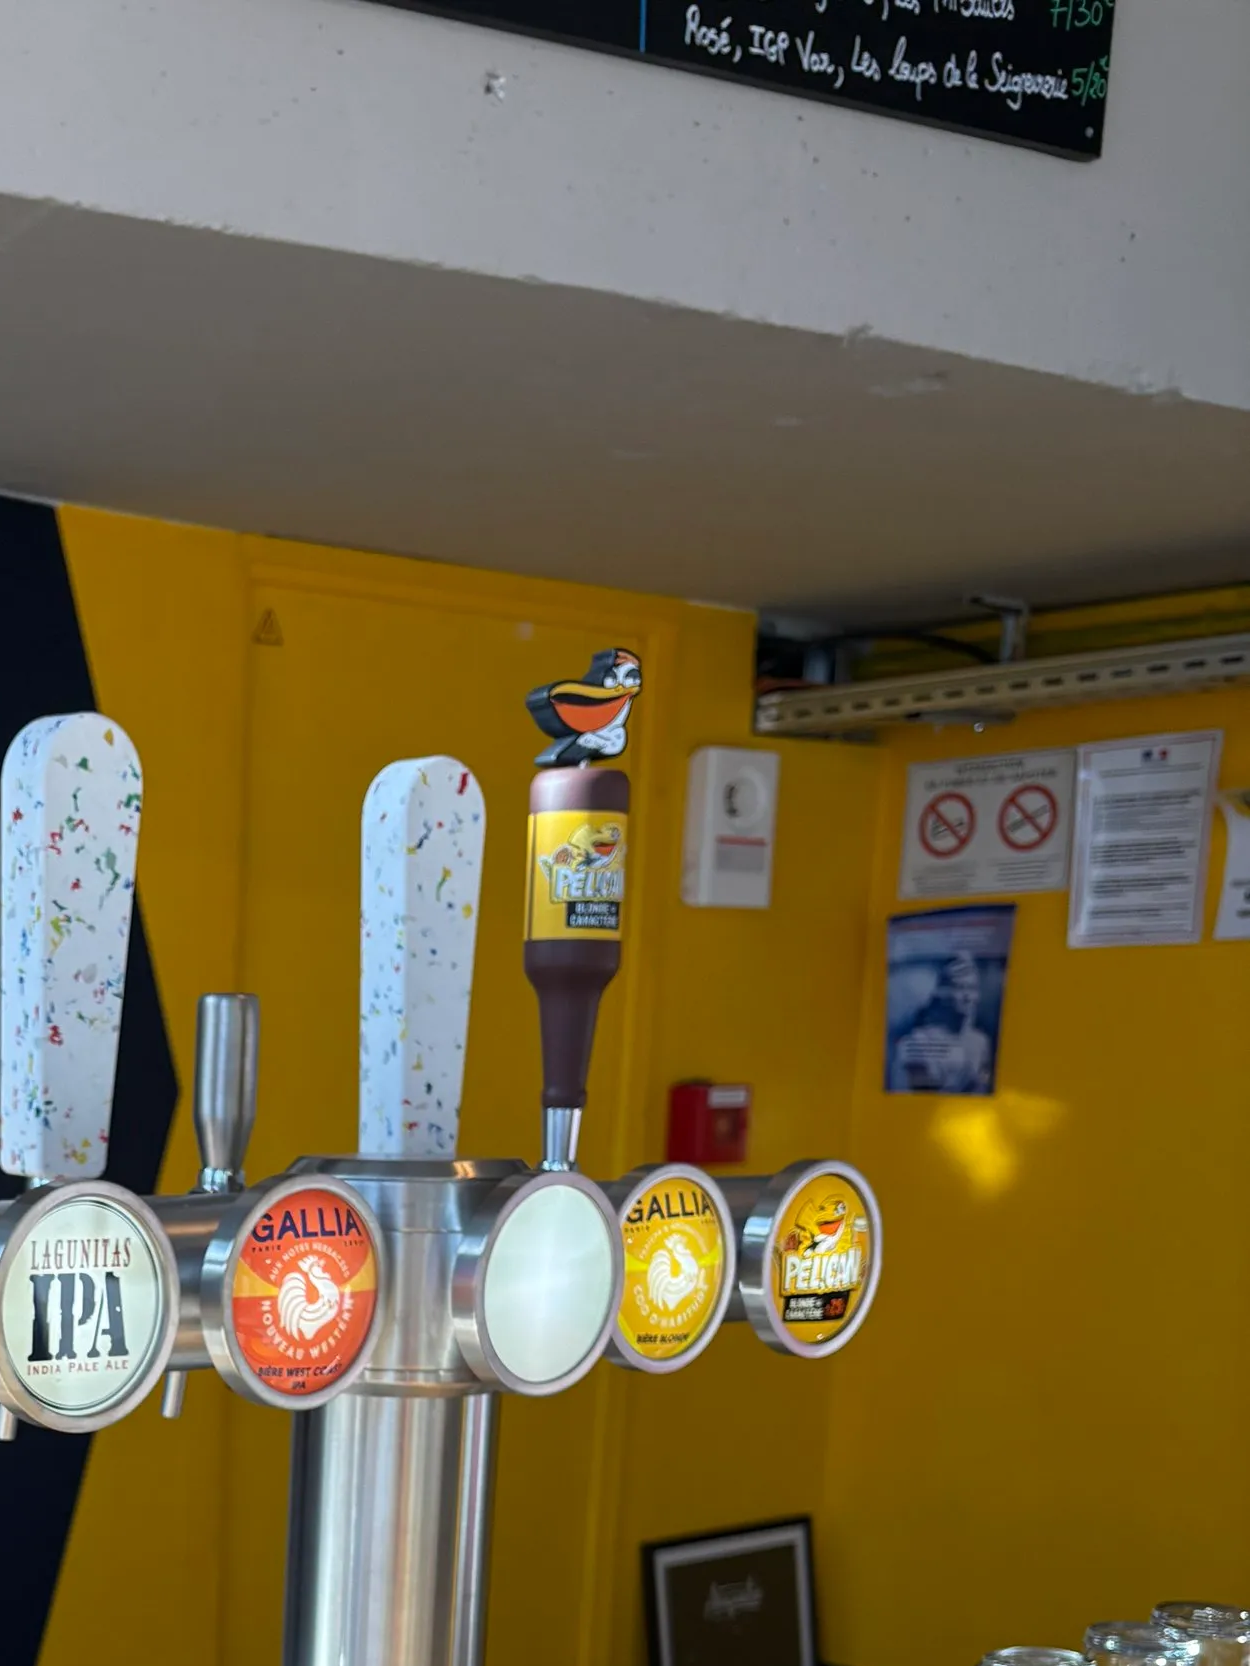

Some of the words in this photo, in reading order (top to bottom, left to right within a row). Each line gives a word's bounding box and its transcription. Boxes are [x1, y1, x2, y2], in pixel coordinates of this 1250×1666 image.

[685, 4, 742, 63] Rosé,
[749, 25, 790, 66] IGP
[852, 35, 881, 81] Les
[943, 54, 962, 88] de
[250, 1207, 362, 1243] GALLIA
[626, 1191, 713, 1224] GALLIA
[30, 1237, 132, 1271] LAGUNITAS
[27, 1271, 129, 1362] IPA
[261, 1299, 305, 1360] NOUVEAU
[27, 1364, 62, 1376] INDIA
[68, 1361, 99, 1373] PALE
[105, 1359, 129, 1371] ALE
